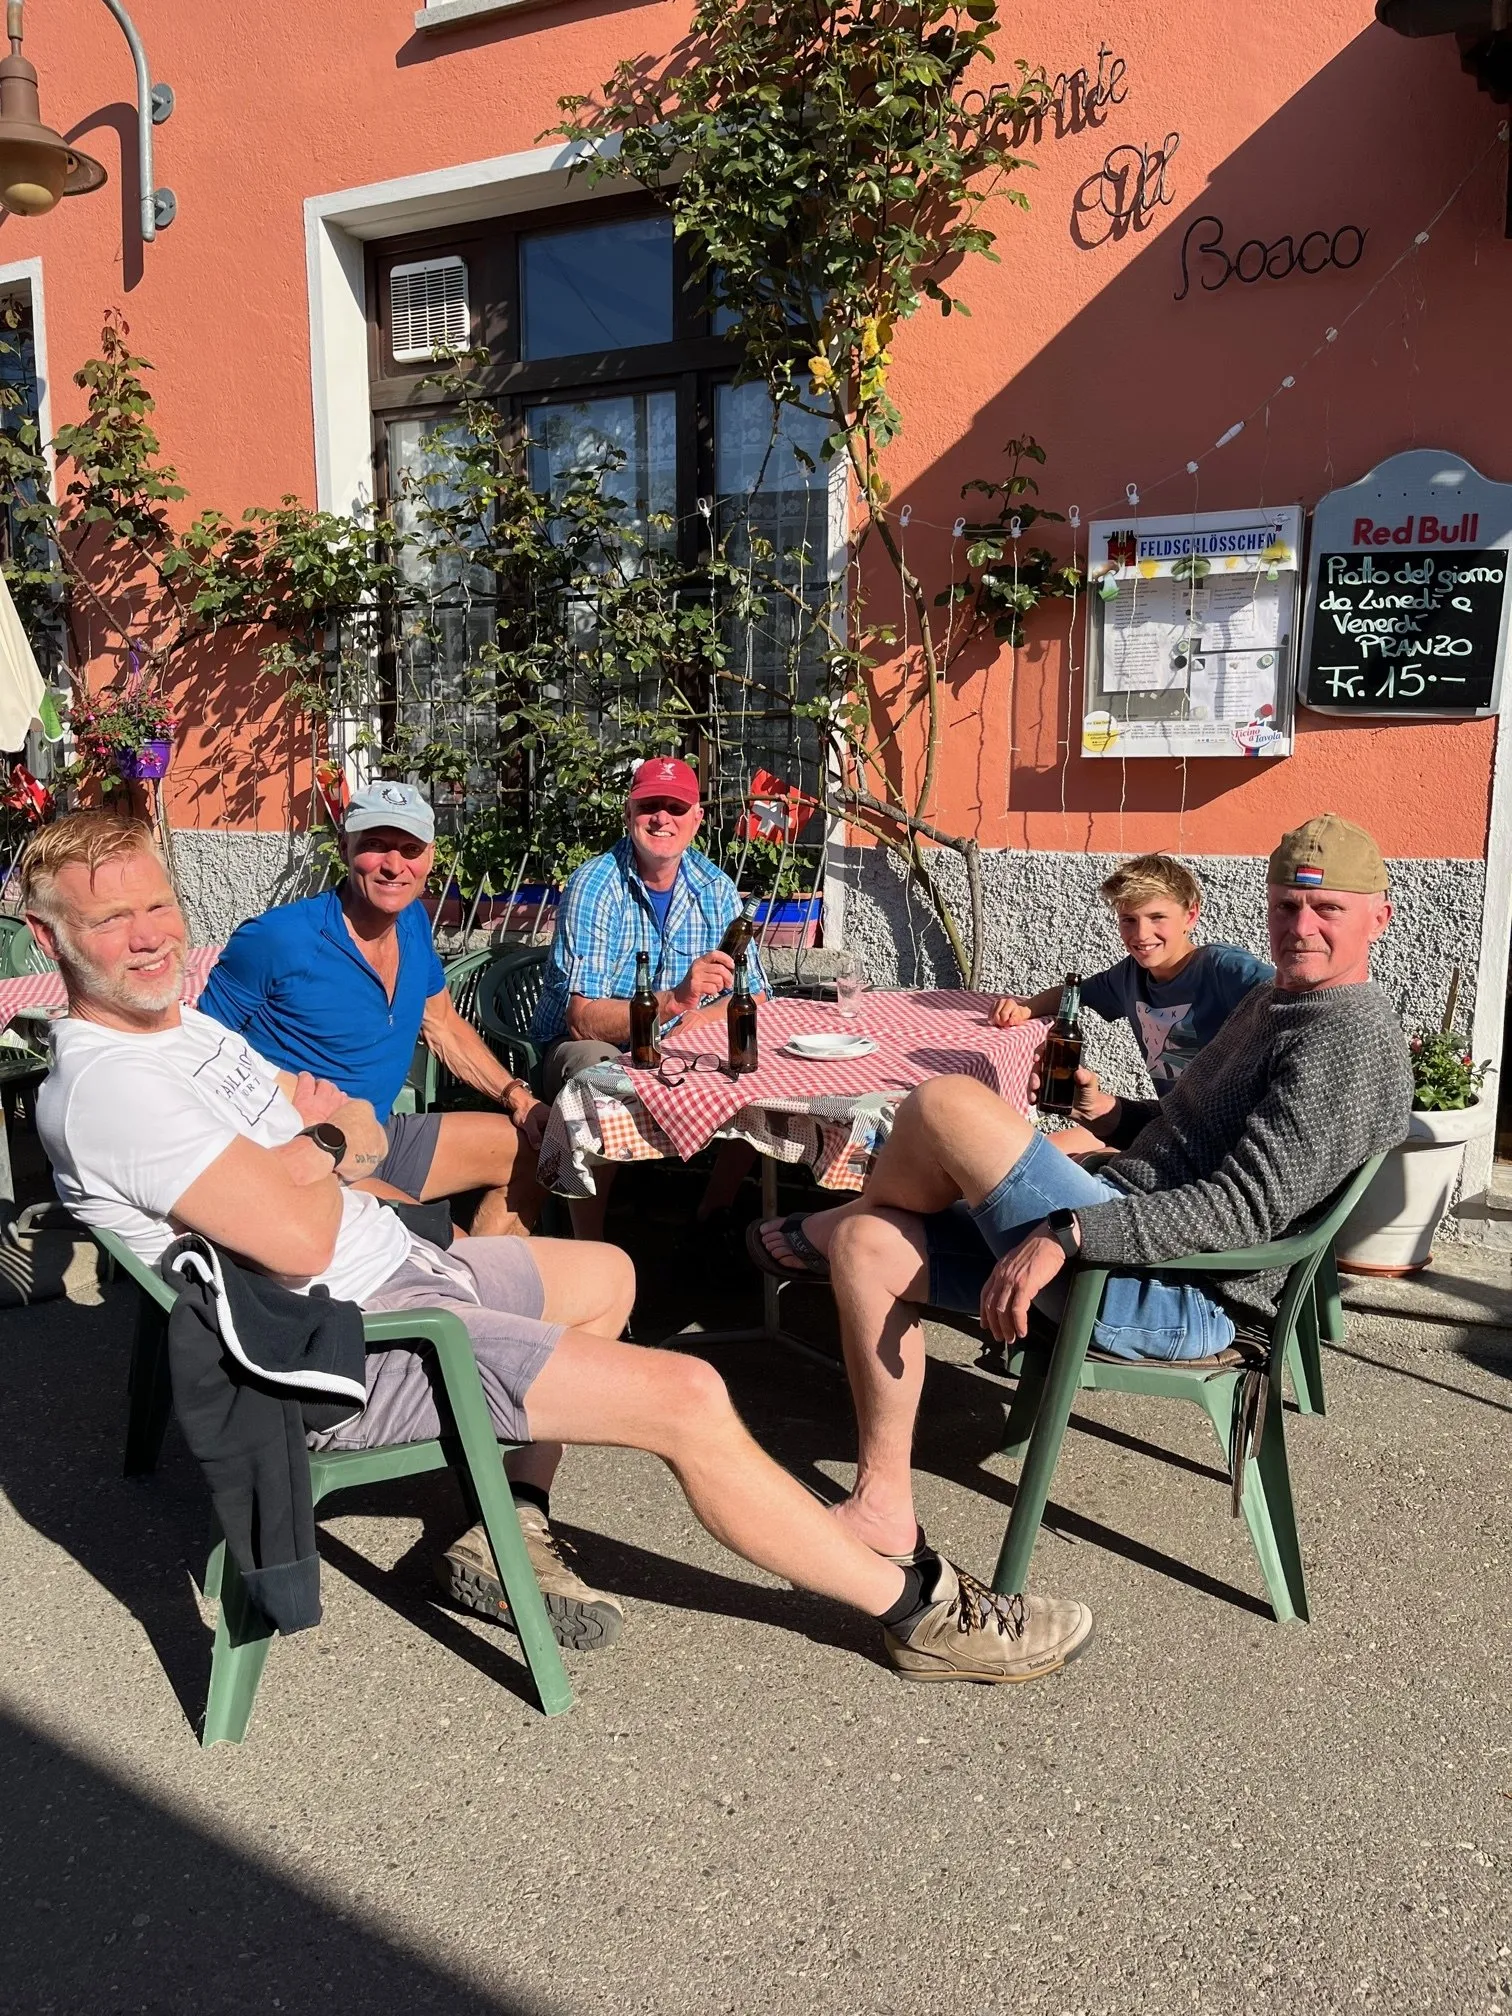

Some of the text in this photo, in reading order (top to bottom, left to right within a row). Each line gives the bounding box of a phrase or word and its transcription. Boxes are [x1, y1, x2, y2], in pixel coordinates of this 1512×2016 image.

[1172, 215, 1370, 301] Bosco
[1353, 513, 1479, 546] Red Bull
[1140, 532, 1277, 557] FELDSCHLÖSSCHEN
[1327, 556, 1391, 585] Piatto
[1394, 558, 1435, 584] del
[1319, 590, 1353, 610] da
[1354, 635, 1473, 658] PRANZO
[1234, 729, 1260, 738] Ticino
[1255, 732, 1281, 743] Tavola
